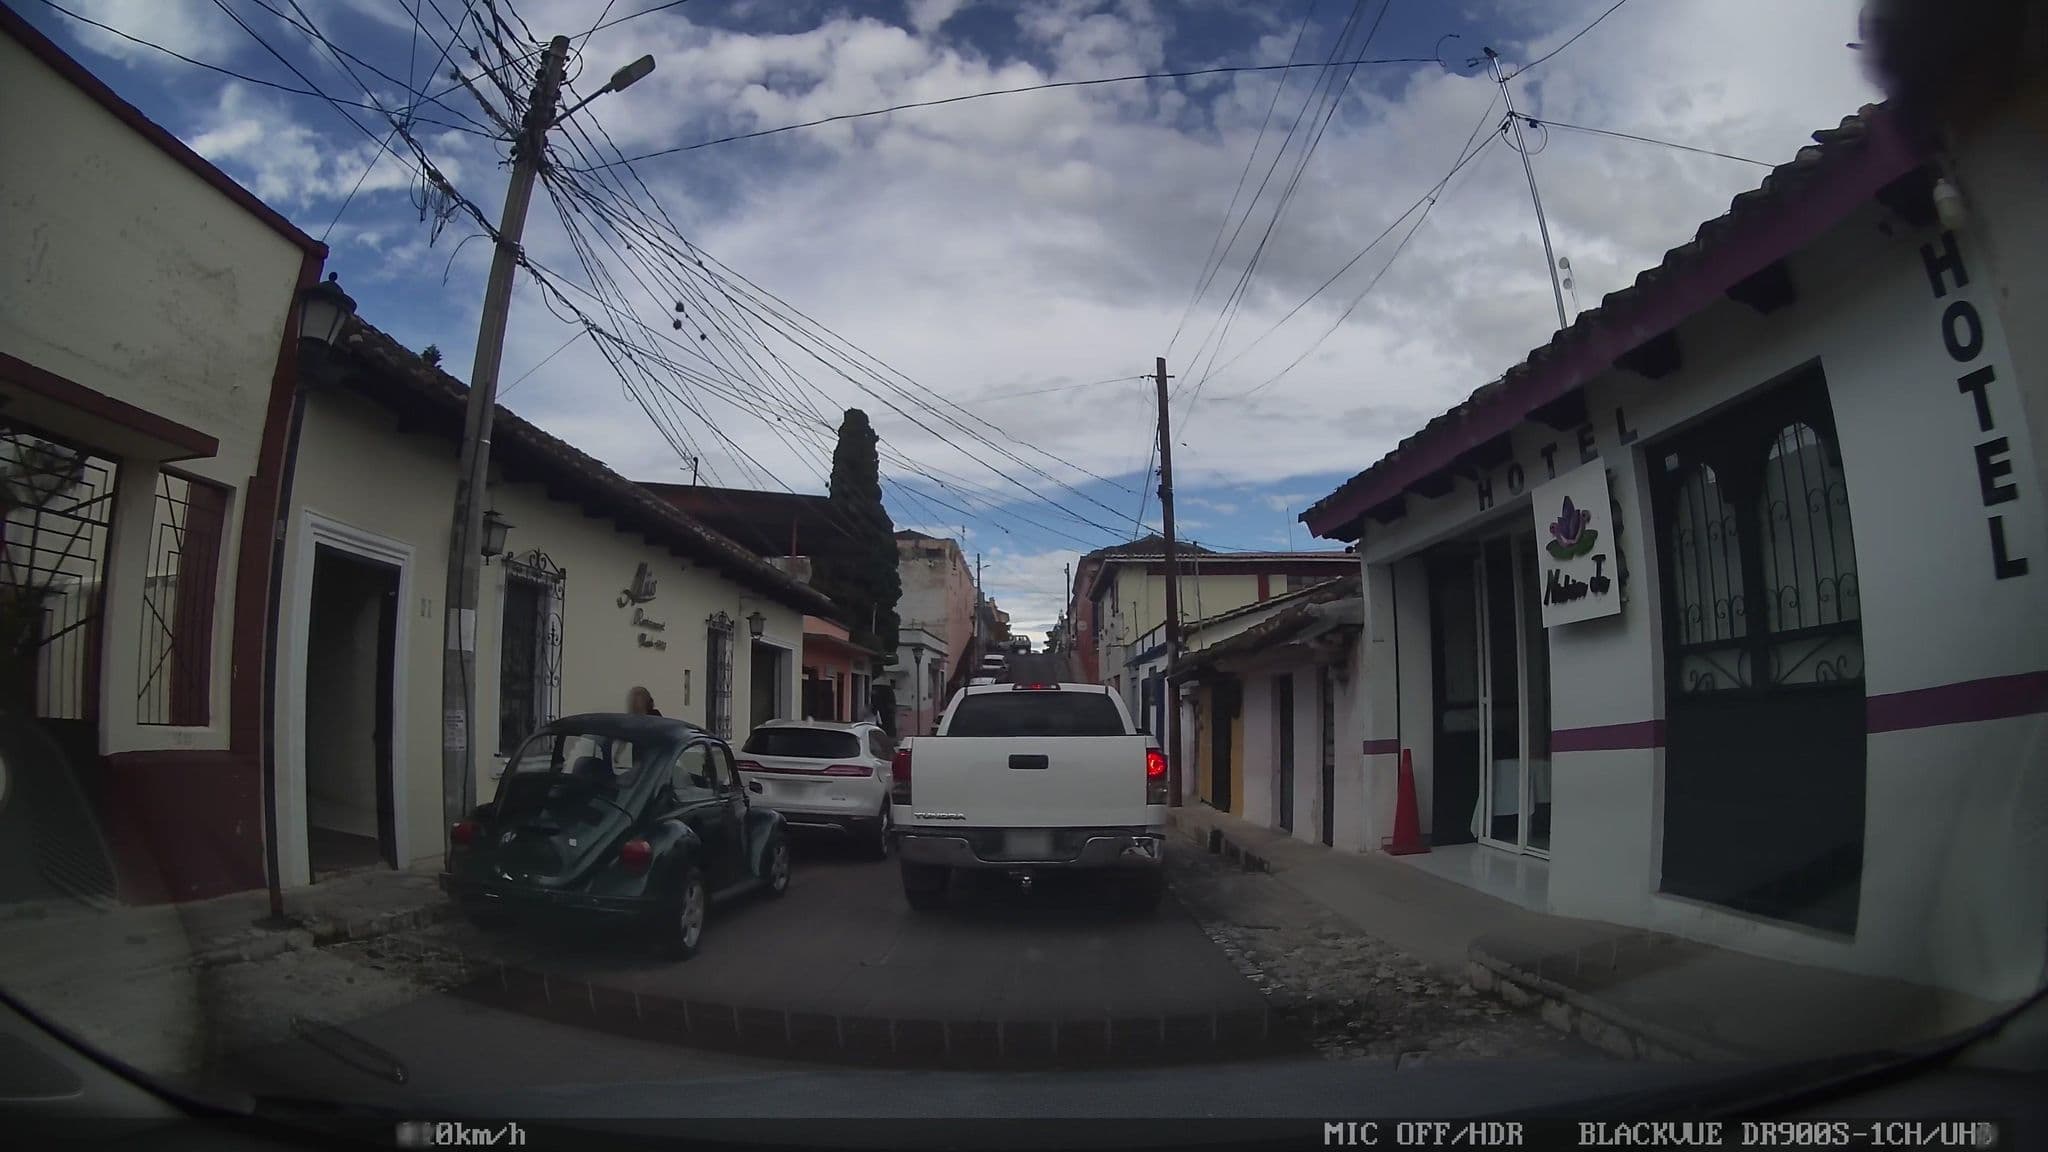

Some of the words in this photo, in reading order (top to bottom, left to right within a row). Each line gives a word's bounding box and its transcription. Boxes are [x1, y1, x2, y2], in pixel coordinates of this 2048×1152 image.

[1919, 229, 2029, 581] HOTEL
[1477, 407, 1638, 511] HOTEL
[914, 811, 967, 821] TUNDRA
